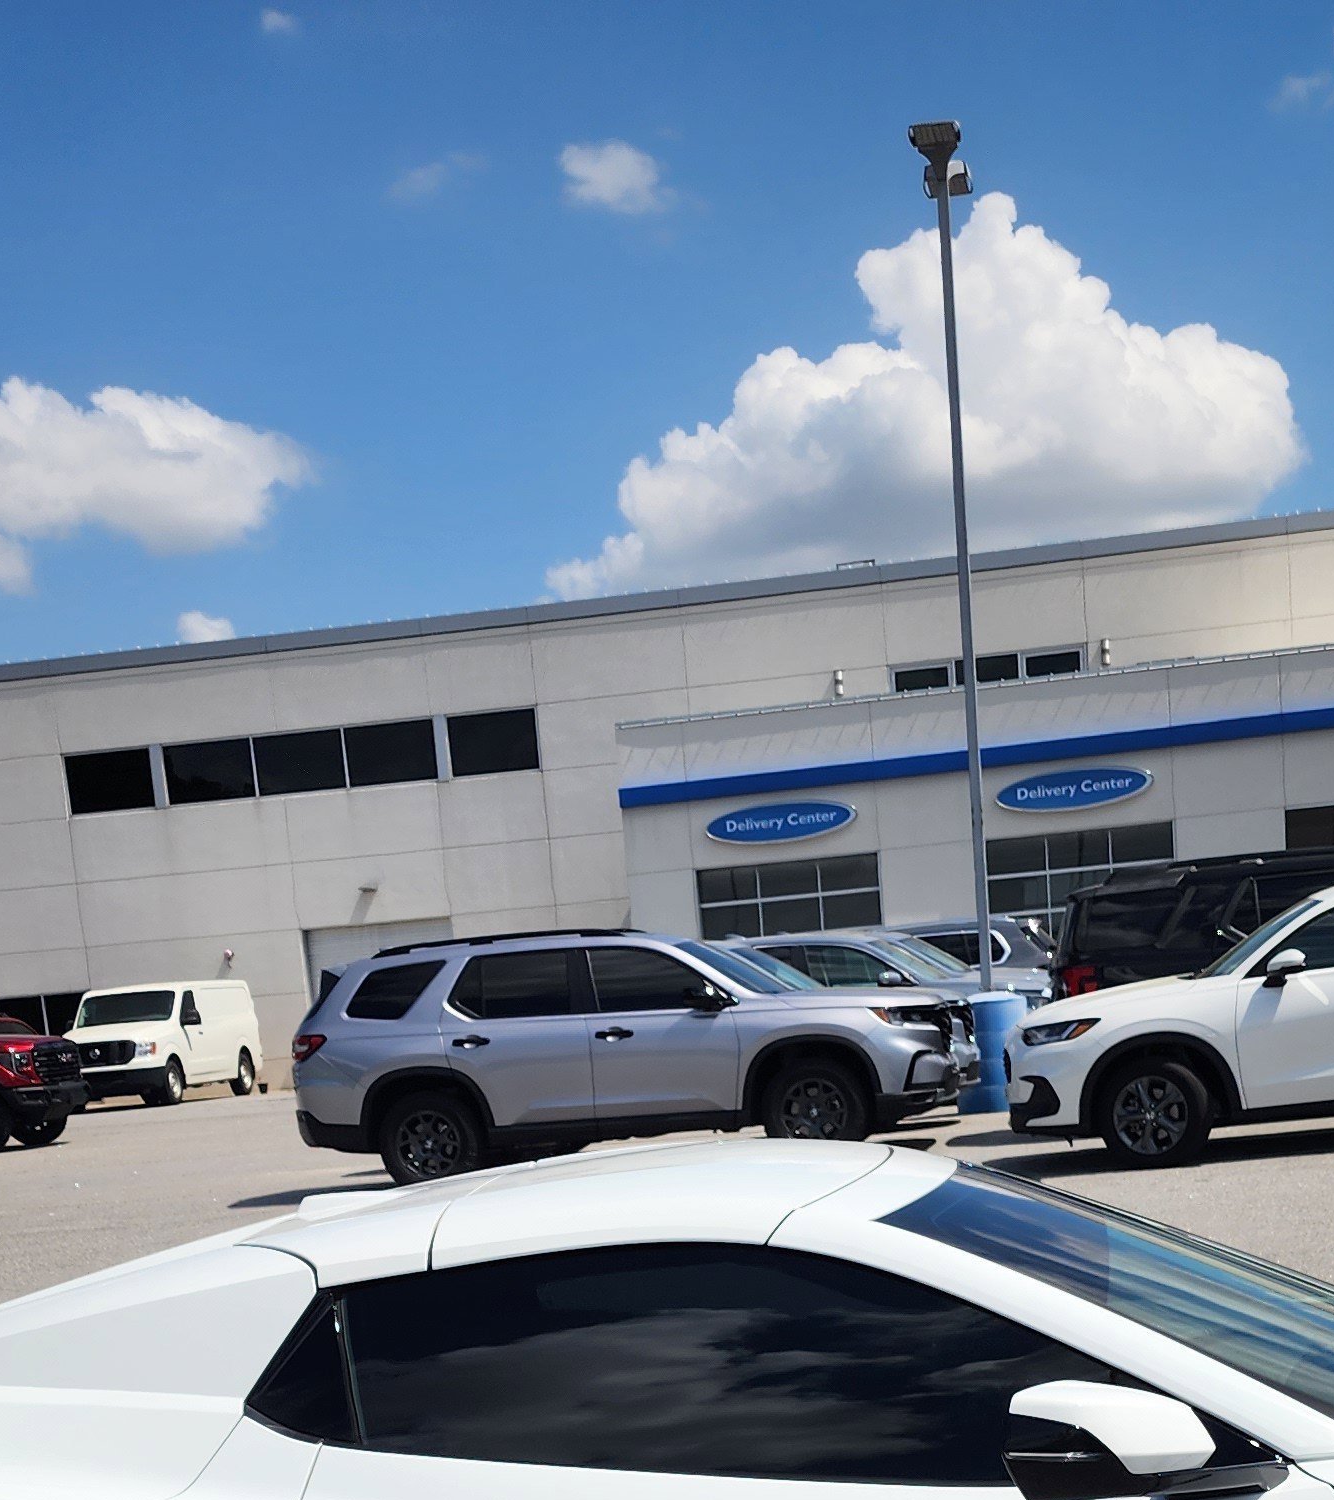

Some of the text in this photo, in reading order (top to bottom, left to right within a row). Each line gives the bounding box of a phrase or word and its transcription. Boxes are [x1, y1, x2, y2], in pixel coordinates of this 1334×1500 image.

[1017, 777, 1132, 800] Delivery Center
[725, 811, 837, 833] Delivery Center
